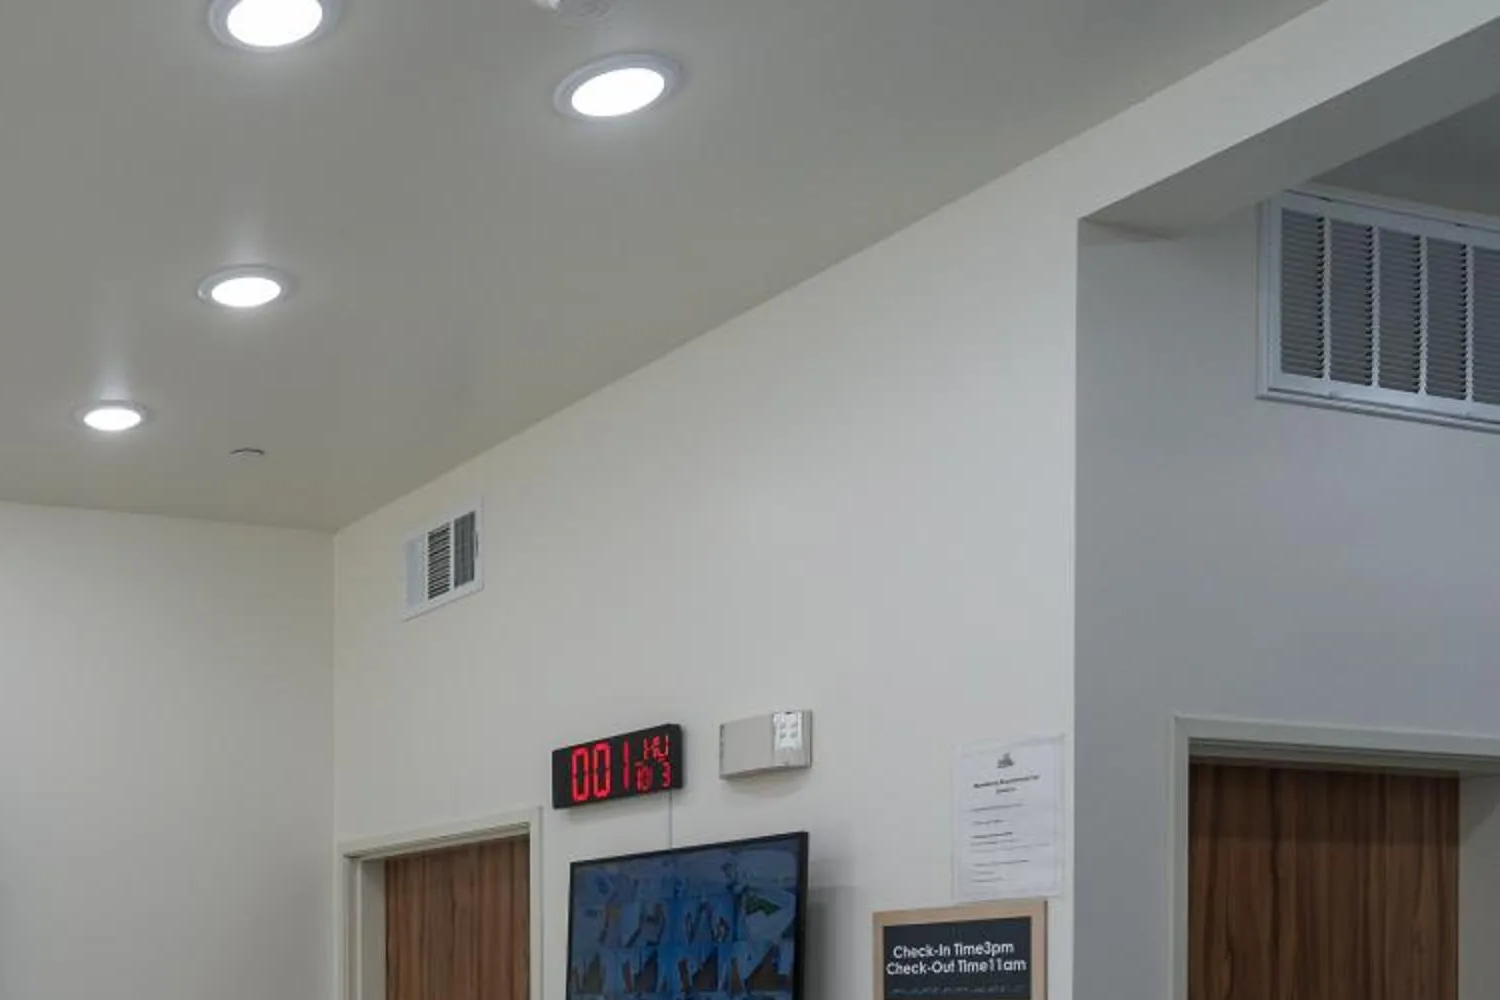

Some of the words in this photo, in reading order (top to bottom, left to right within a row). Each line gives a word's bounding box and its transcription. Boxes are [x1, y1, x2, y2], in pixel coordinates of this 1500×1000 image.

[893, 943, 951, 959] Check-In
[954, 941, 1015, 957] Time3pm
[886, 960, 955, 975] Check-Out
